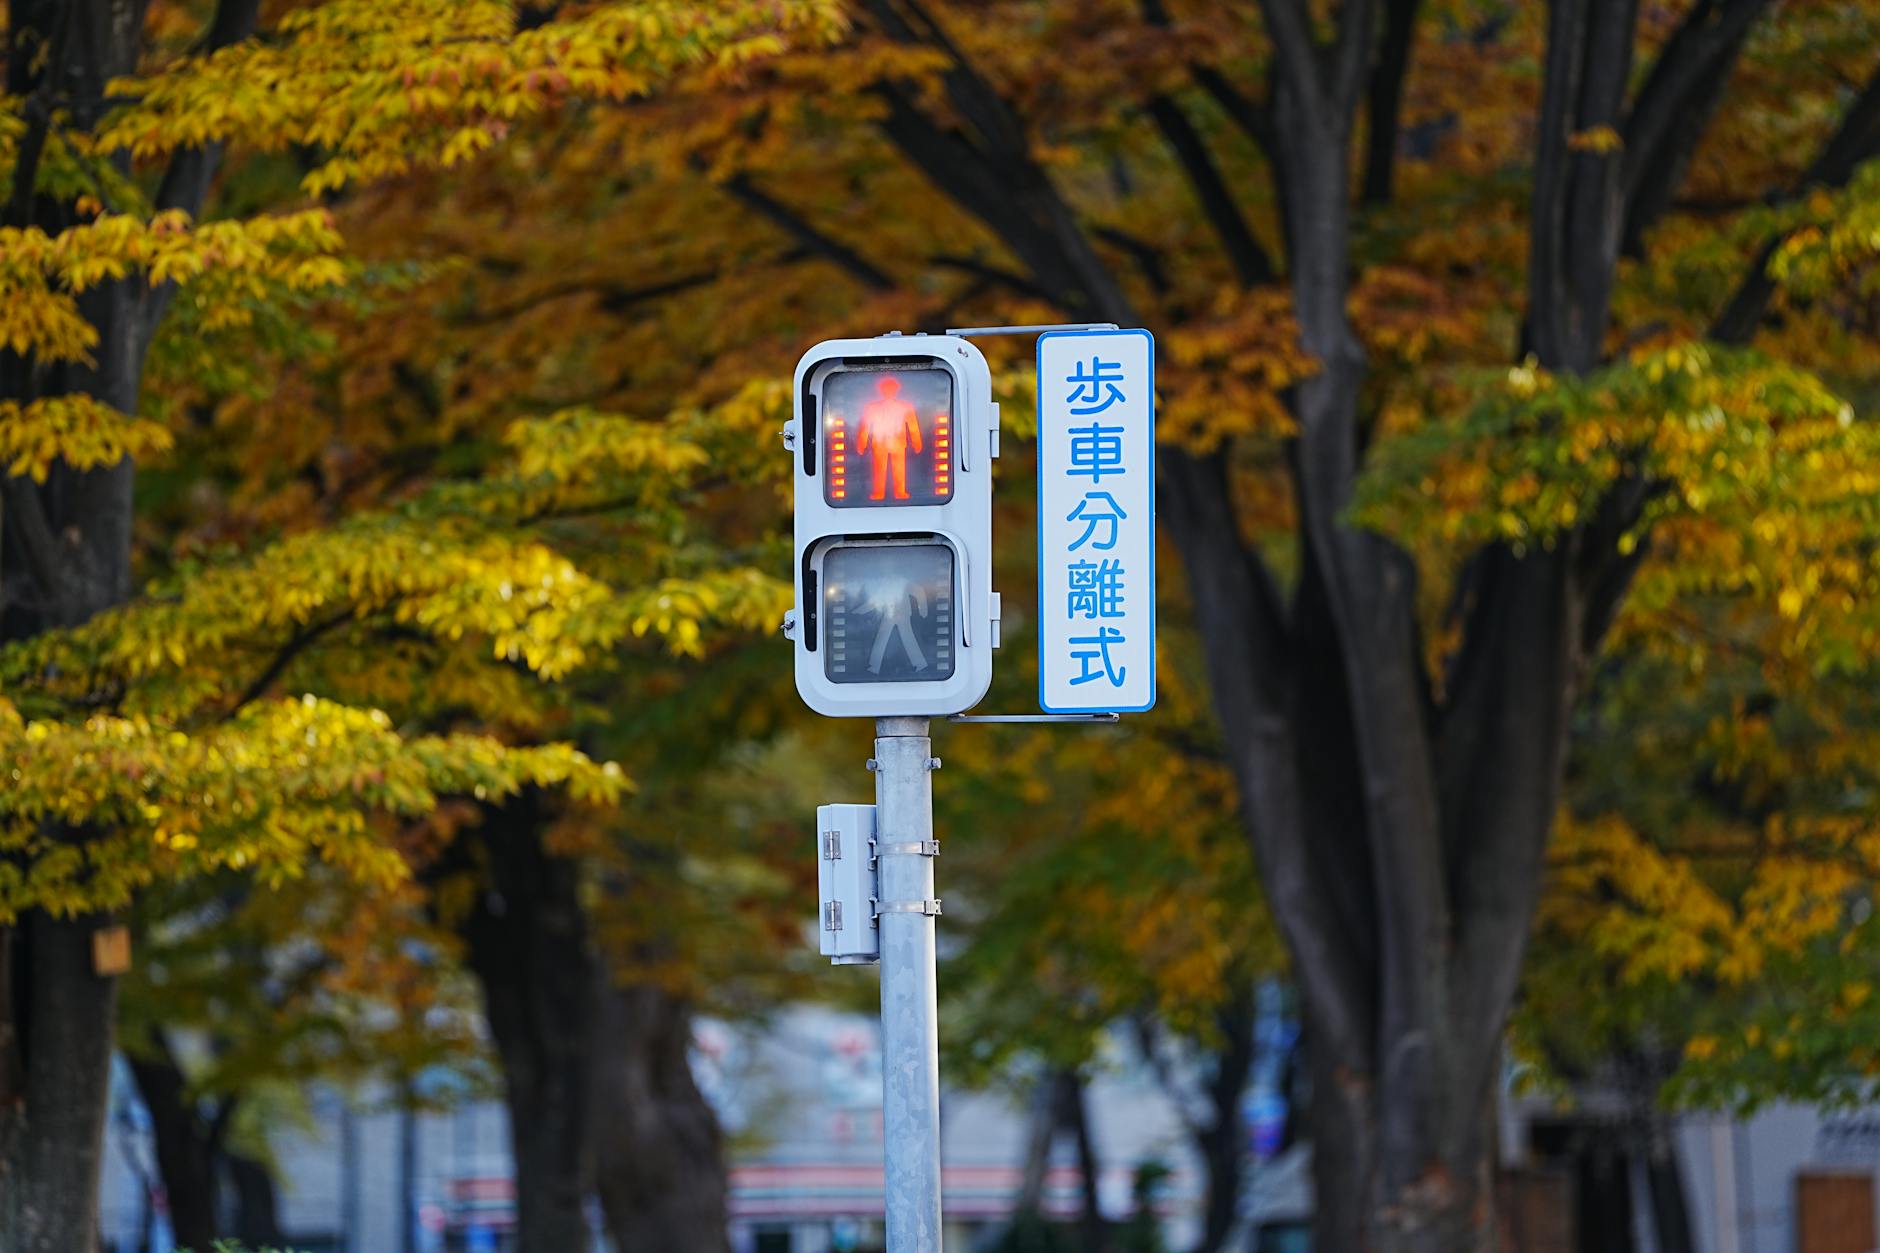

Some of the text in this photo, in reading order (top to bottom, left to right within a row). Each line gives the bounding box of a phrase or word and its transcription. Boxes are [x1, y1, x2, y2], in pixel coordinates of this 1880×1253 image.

[1066, 356, 1127, 687] 歩車分離式
